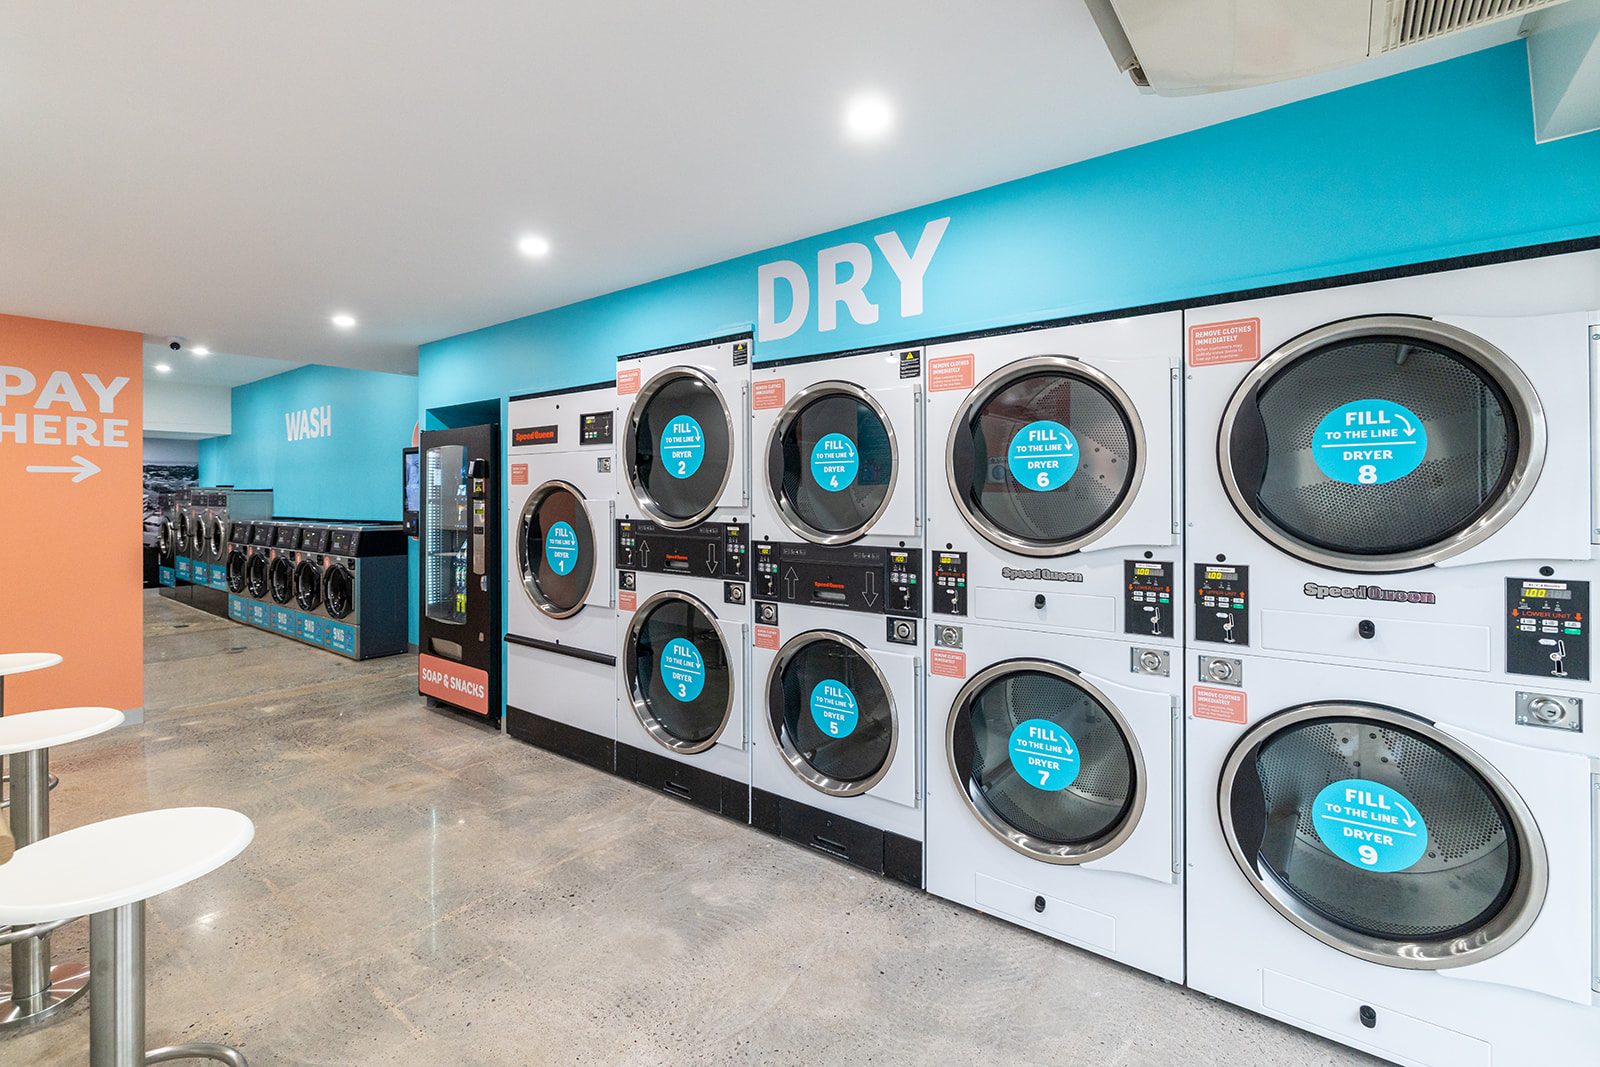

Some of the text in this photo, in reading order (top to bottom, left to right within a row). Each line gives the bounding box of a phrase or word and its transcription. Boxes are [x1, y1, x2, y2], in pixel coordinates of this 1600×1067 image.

[758, 216, 950, 342] DRY
[1195, 326, 1252, 338] REMOVE CLOTHES
[1195, 335, 1238, 345] IMMEDIATELY
[0, 366, 130, 414] PAY
[285, 405, 331, 442] WASH
[1346, 410, 1390, 426] FILL
[0, 412, 128, 448] HERE
[674, 423, 691, 433] FILL
[1325, 428, 1398, 440] TO THE LINE
[516, 431, 554, 442] Speed Queen
[1029, 430, 1057, 441] FILL
[825, 440, 843, 450] FILL
[1343, 450, 1393, 461] DRYER
[678, 461, 686, 474] 2
[1028, 460, 1059, 469] DRYER
[1037, 472, 1049, 487] 6
[1358, 465, 1377, 484] 8
[830, 475, 839, 488] 4
[555, 528, 568, 537] FILL
[558, 560, 564, 572] 1
[1002, 567, 1083, 582] Speed Queen
[1304, 582, 1436, 604] Speed Queen
[333, 627, 344, 642] 9KG
[674, 645, 691, 657] FILL
[422, 668, 484, 698] SOAP & SNACKS
[672, 672, 692, 682] DRYER
[678, 684, 686, 697] 3
[824, 686, 843, 698] FILL
[824, 711, 845, 721] DRYER
[830, 722, 838, 734] 5
[1029, 726, 1058, 742] FILL
[1028, 741, 1044, 750] THE
[1045, 744, 1062, 754] LINE
[1028, 757, 1060, 770] DRYER
[1038, 770, 1050, 786] 7
[1346, 788, 1391, 810] FILL
[1325, 803, 1398, 825] TO THE LINE
[1343, 827, 1394, 846] DRYER
[1358, 845, 1378, 865] 9
